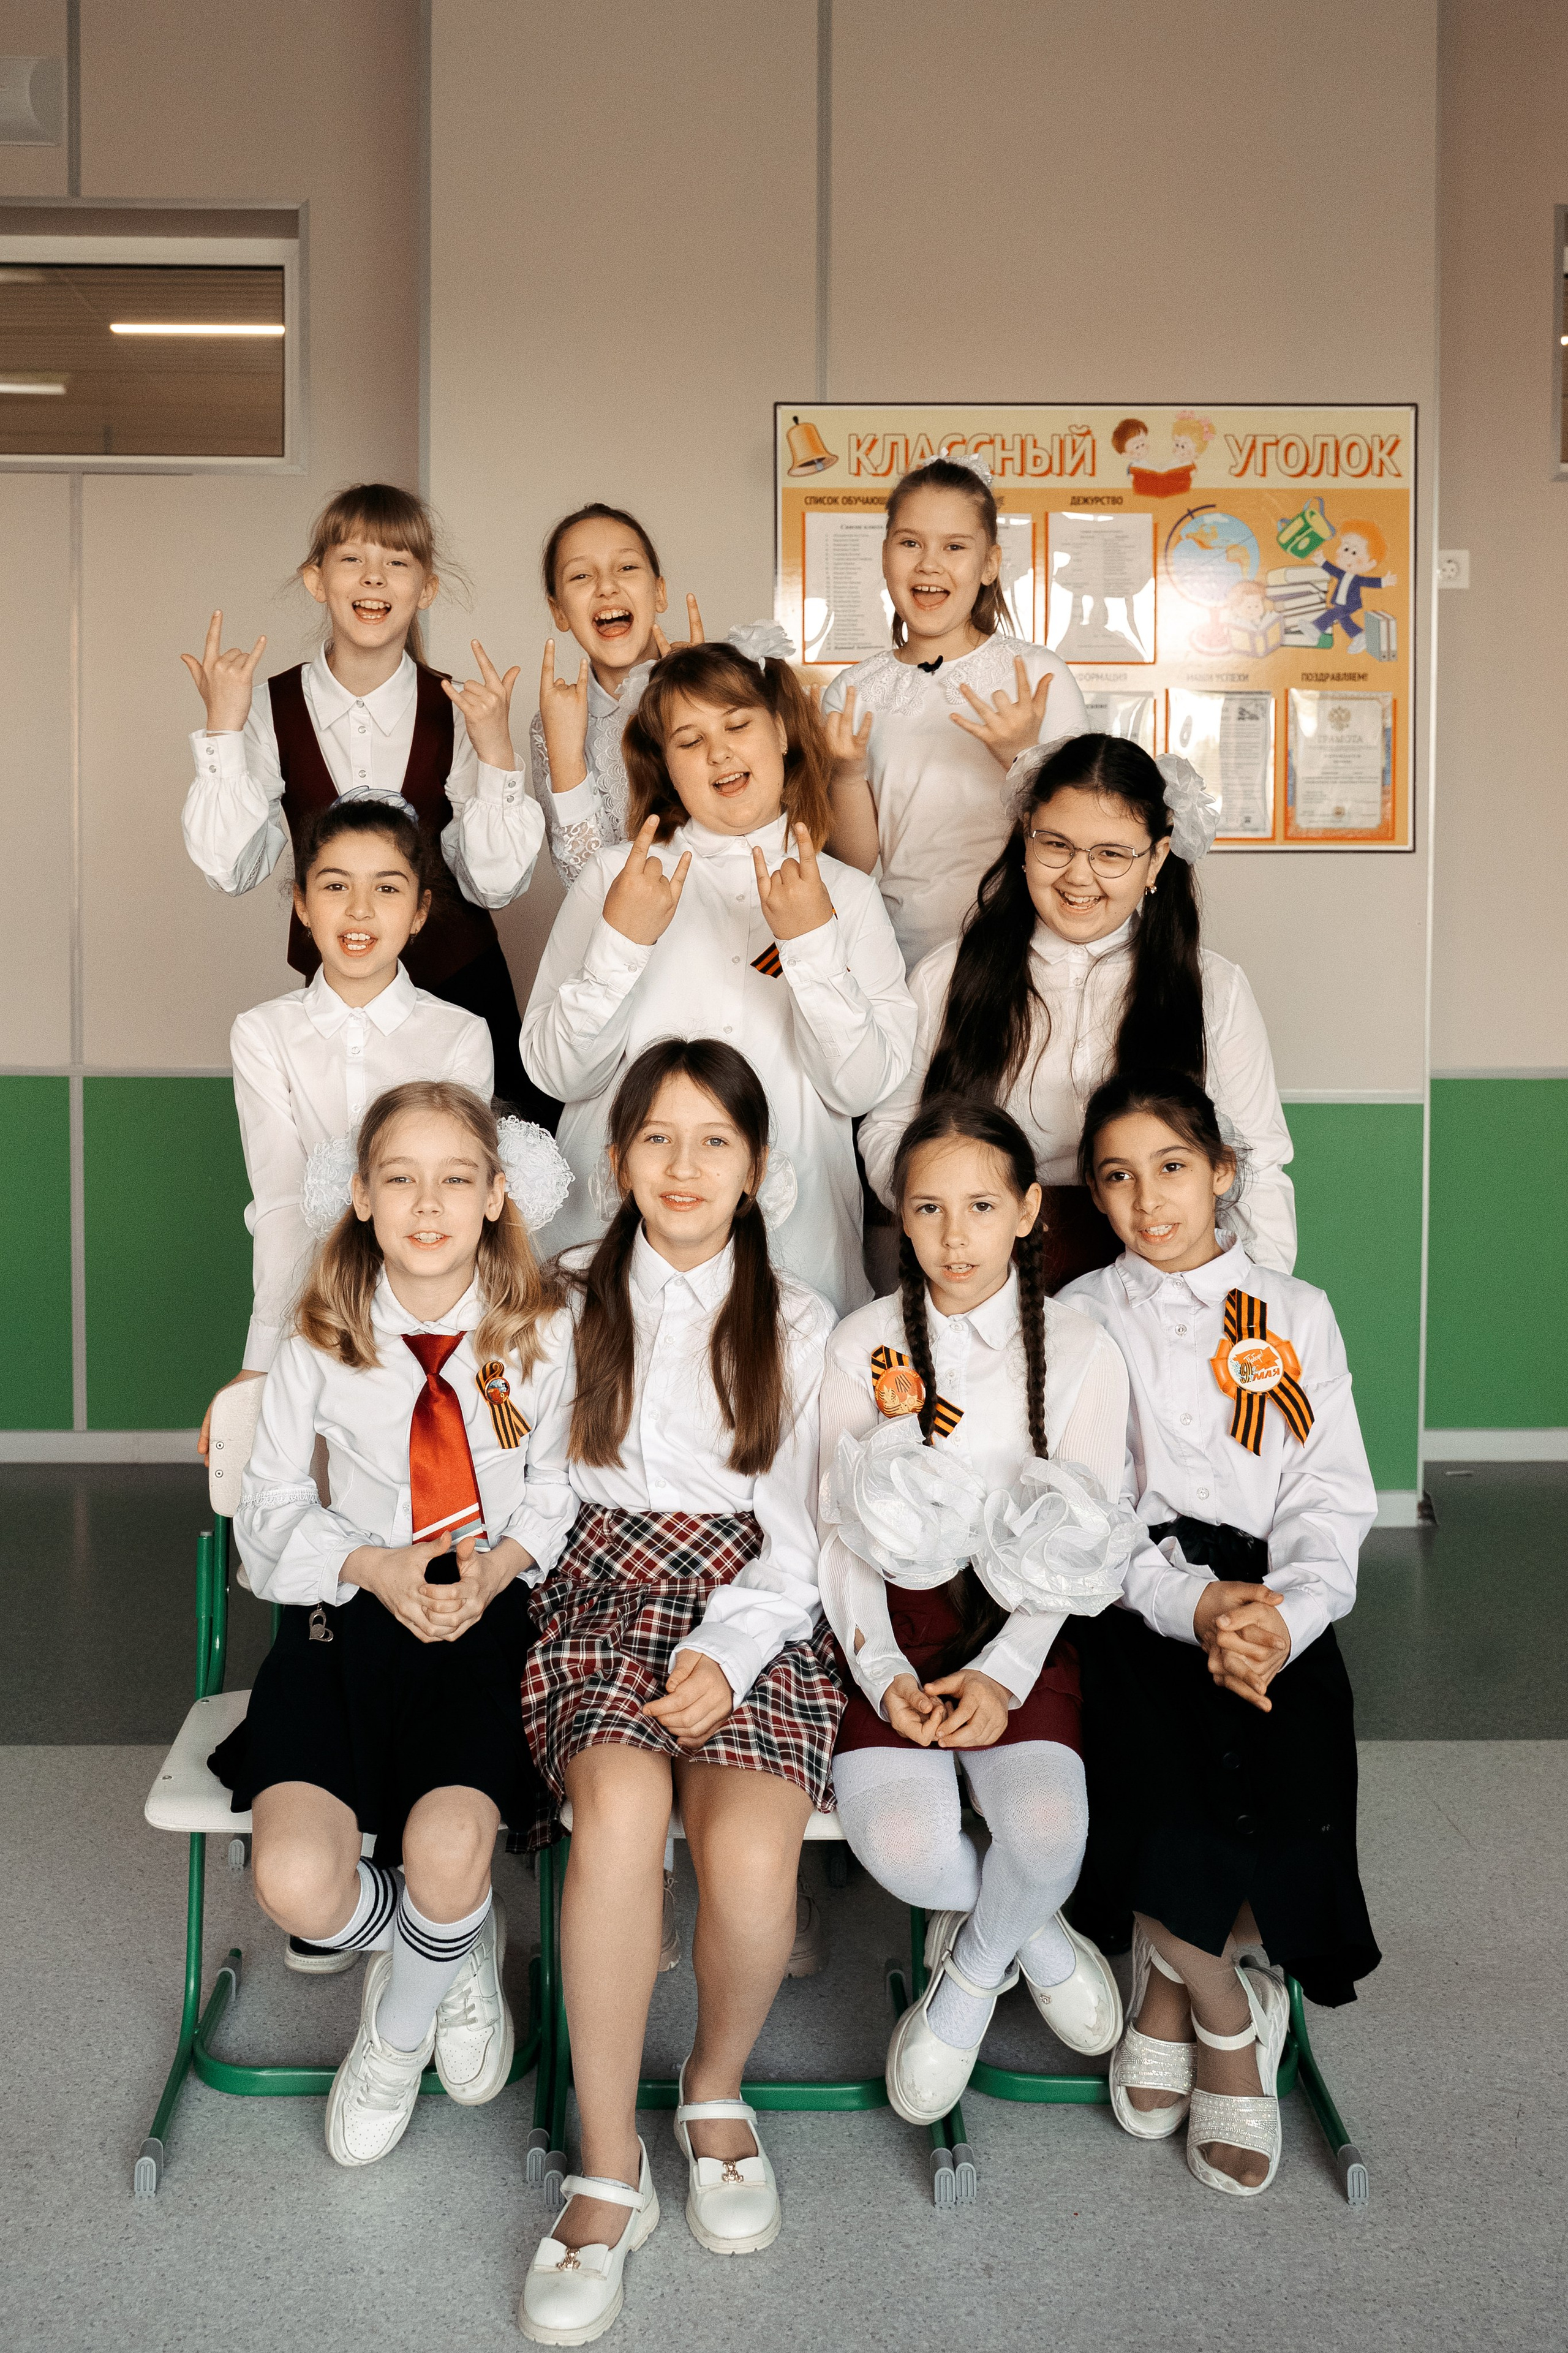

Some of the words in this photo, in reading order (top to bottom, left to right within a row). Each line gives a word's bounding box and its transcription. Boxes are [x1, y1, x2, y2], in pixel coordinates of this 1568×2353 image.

[1224, 433, 1403, 478] УГОЛОК
[804, 496, 839, 505] СПИСОК
[841, 496, 887, 505] ОБУЧАЮЩ
[1070, 496, 1123, 505] ДЕЖУРСТВО
[1077, 673, 1128, 682] ФОРМАЦИЯ
[1186, 673, 1213, 682] НАШИ
[1215, 673, 1249, 682] УСПЕХИ
[1301, 672, 1369, 682] ПОЗДРАВЛЯЕМ!
[1240, 1362, 1253, 1384] 9
[1253, 1368, 1280, 1381] МАЯ
